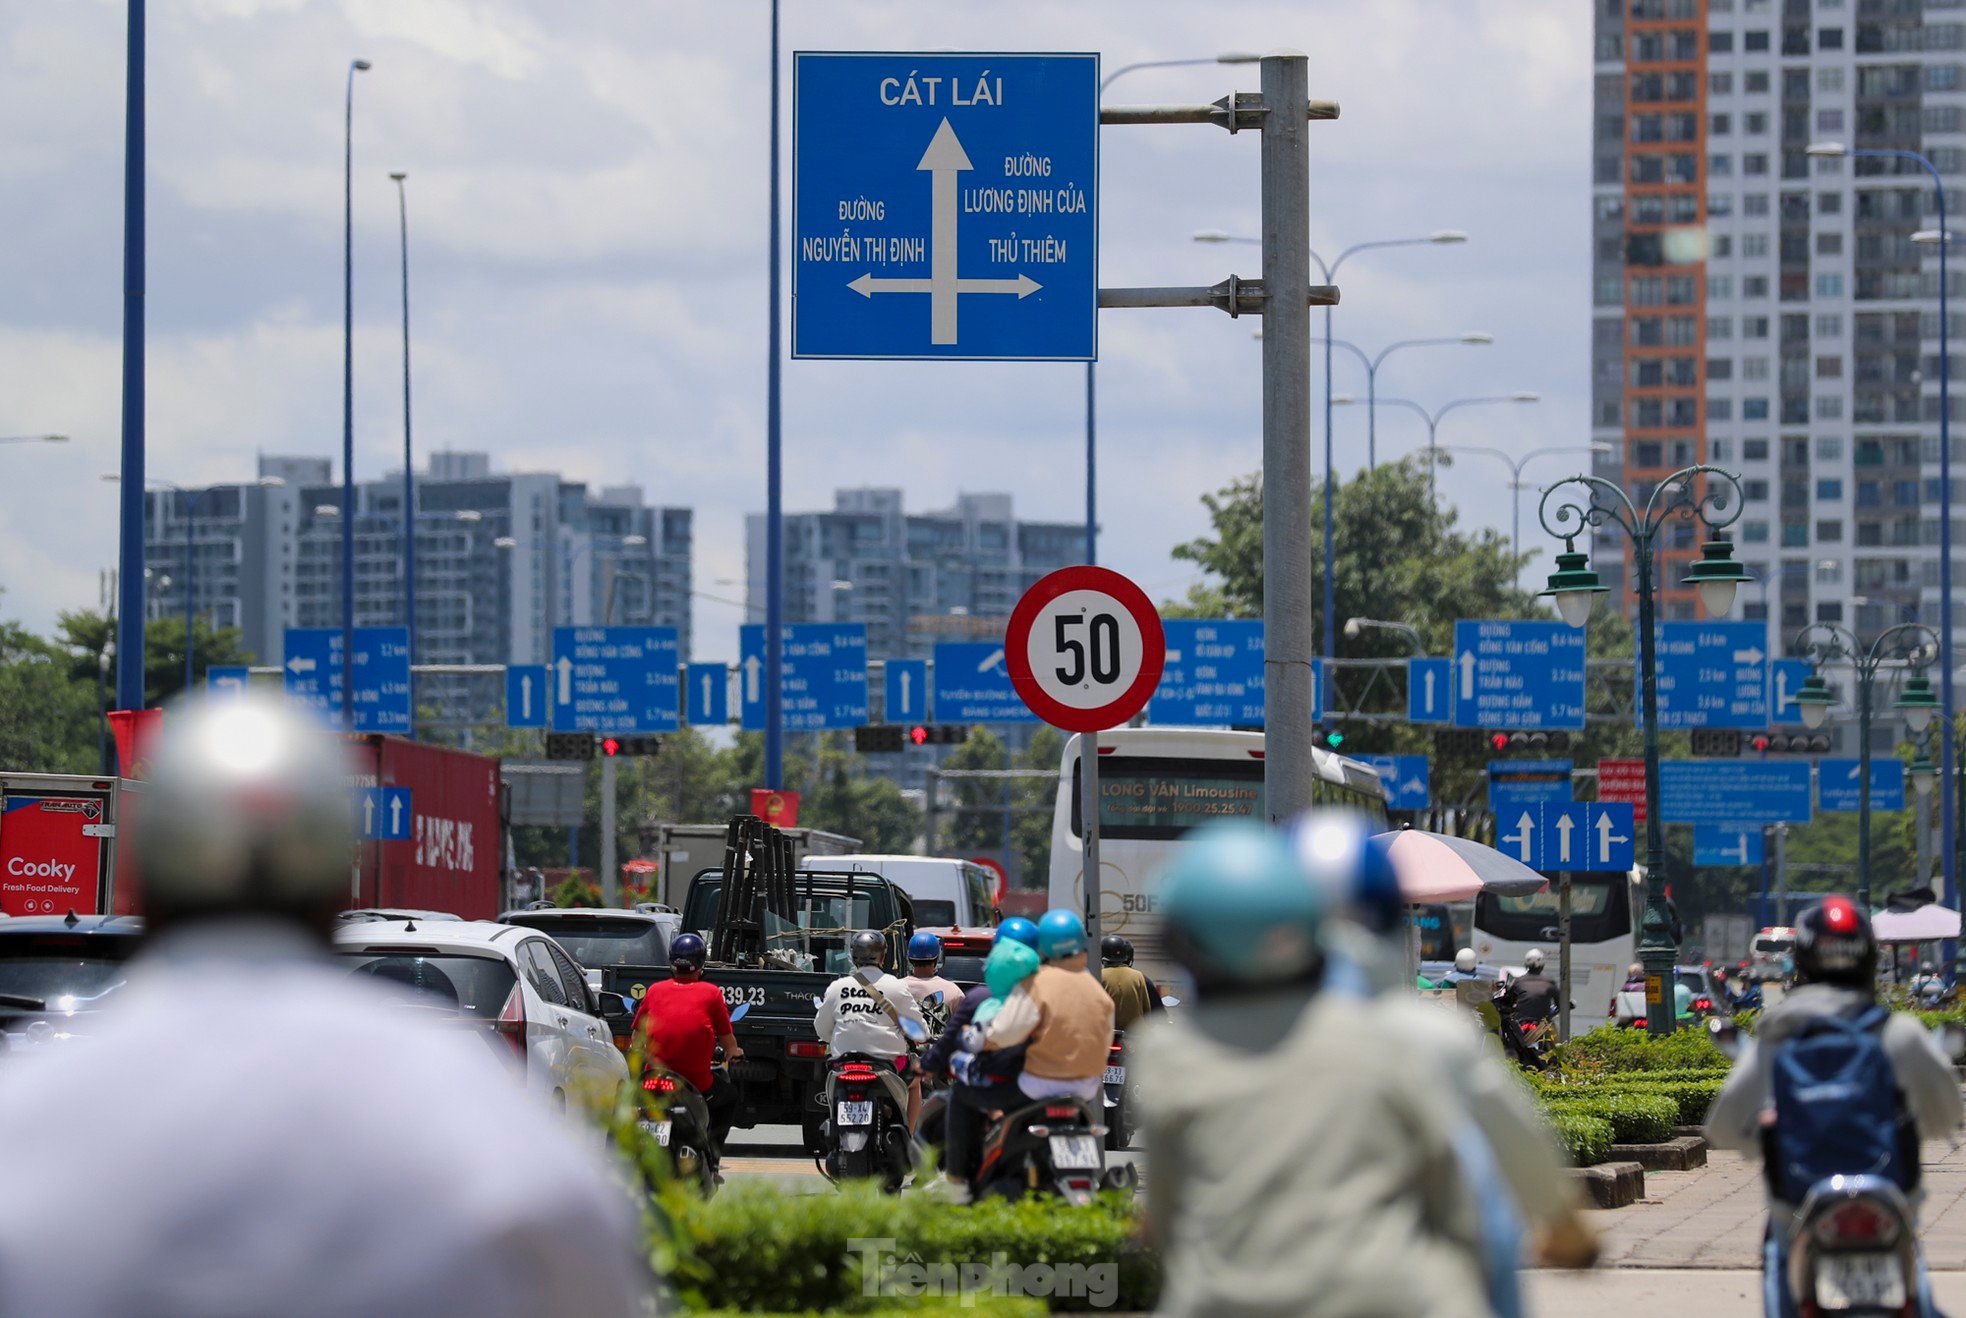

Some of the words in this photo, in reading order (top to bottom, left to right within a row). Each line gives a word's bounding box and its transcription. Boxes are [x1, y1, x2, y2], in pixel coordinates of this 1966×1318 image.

[880, 70, 942, 106] CÁT
[952, 70, 1002, 106] LÁI
[1004, 152, 1051, 177] ĐƯỜNG
[838, 195, 885, 221] ĐƯỜNG
[964, 187, 1014, 213] LƯƠNG
[1018, 188, 1053, 217] ĐỊNH
[1057, 182, 1086, 214] CỦA
[803, 228, 860, 262] NGUYỄN
[864, 237, 886, 267] THỊ
[890, 237, 925, 267] ĐỊNH
[988, 232, 1018, 263] THỦ
[1022, 235, 1066, 263] THIÊM
[1055, 613, 1121, 685] 50
[1102, 783, 1145, 797] LONG
[1184, 784, 1258, 799] Limousine
[8, 857, 76, 882] Cooky
[3, 883, 25, 891] Fresh
[26, 883, 46, 892] Food
[47, 885, 80, 895] Delivery
[784, 991, 816, 1001] THACO
[840, 1002, 883, 1015] Park
[844, 1104, 867, 1113] 59-X4
